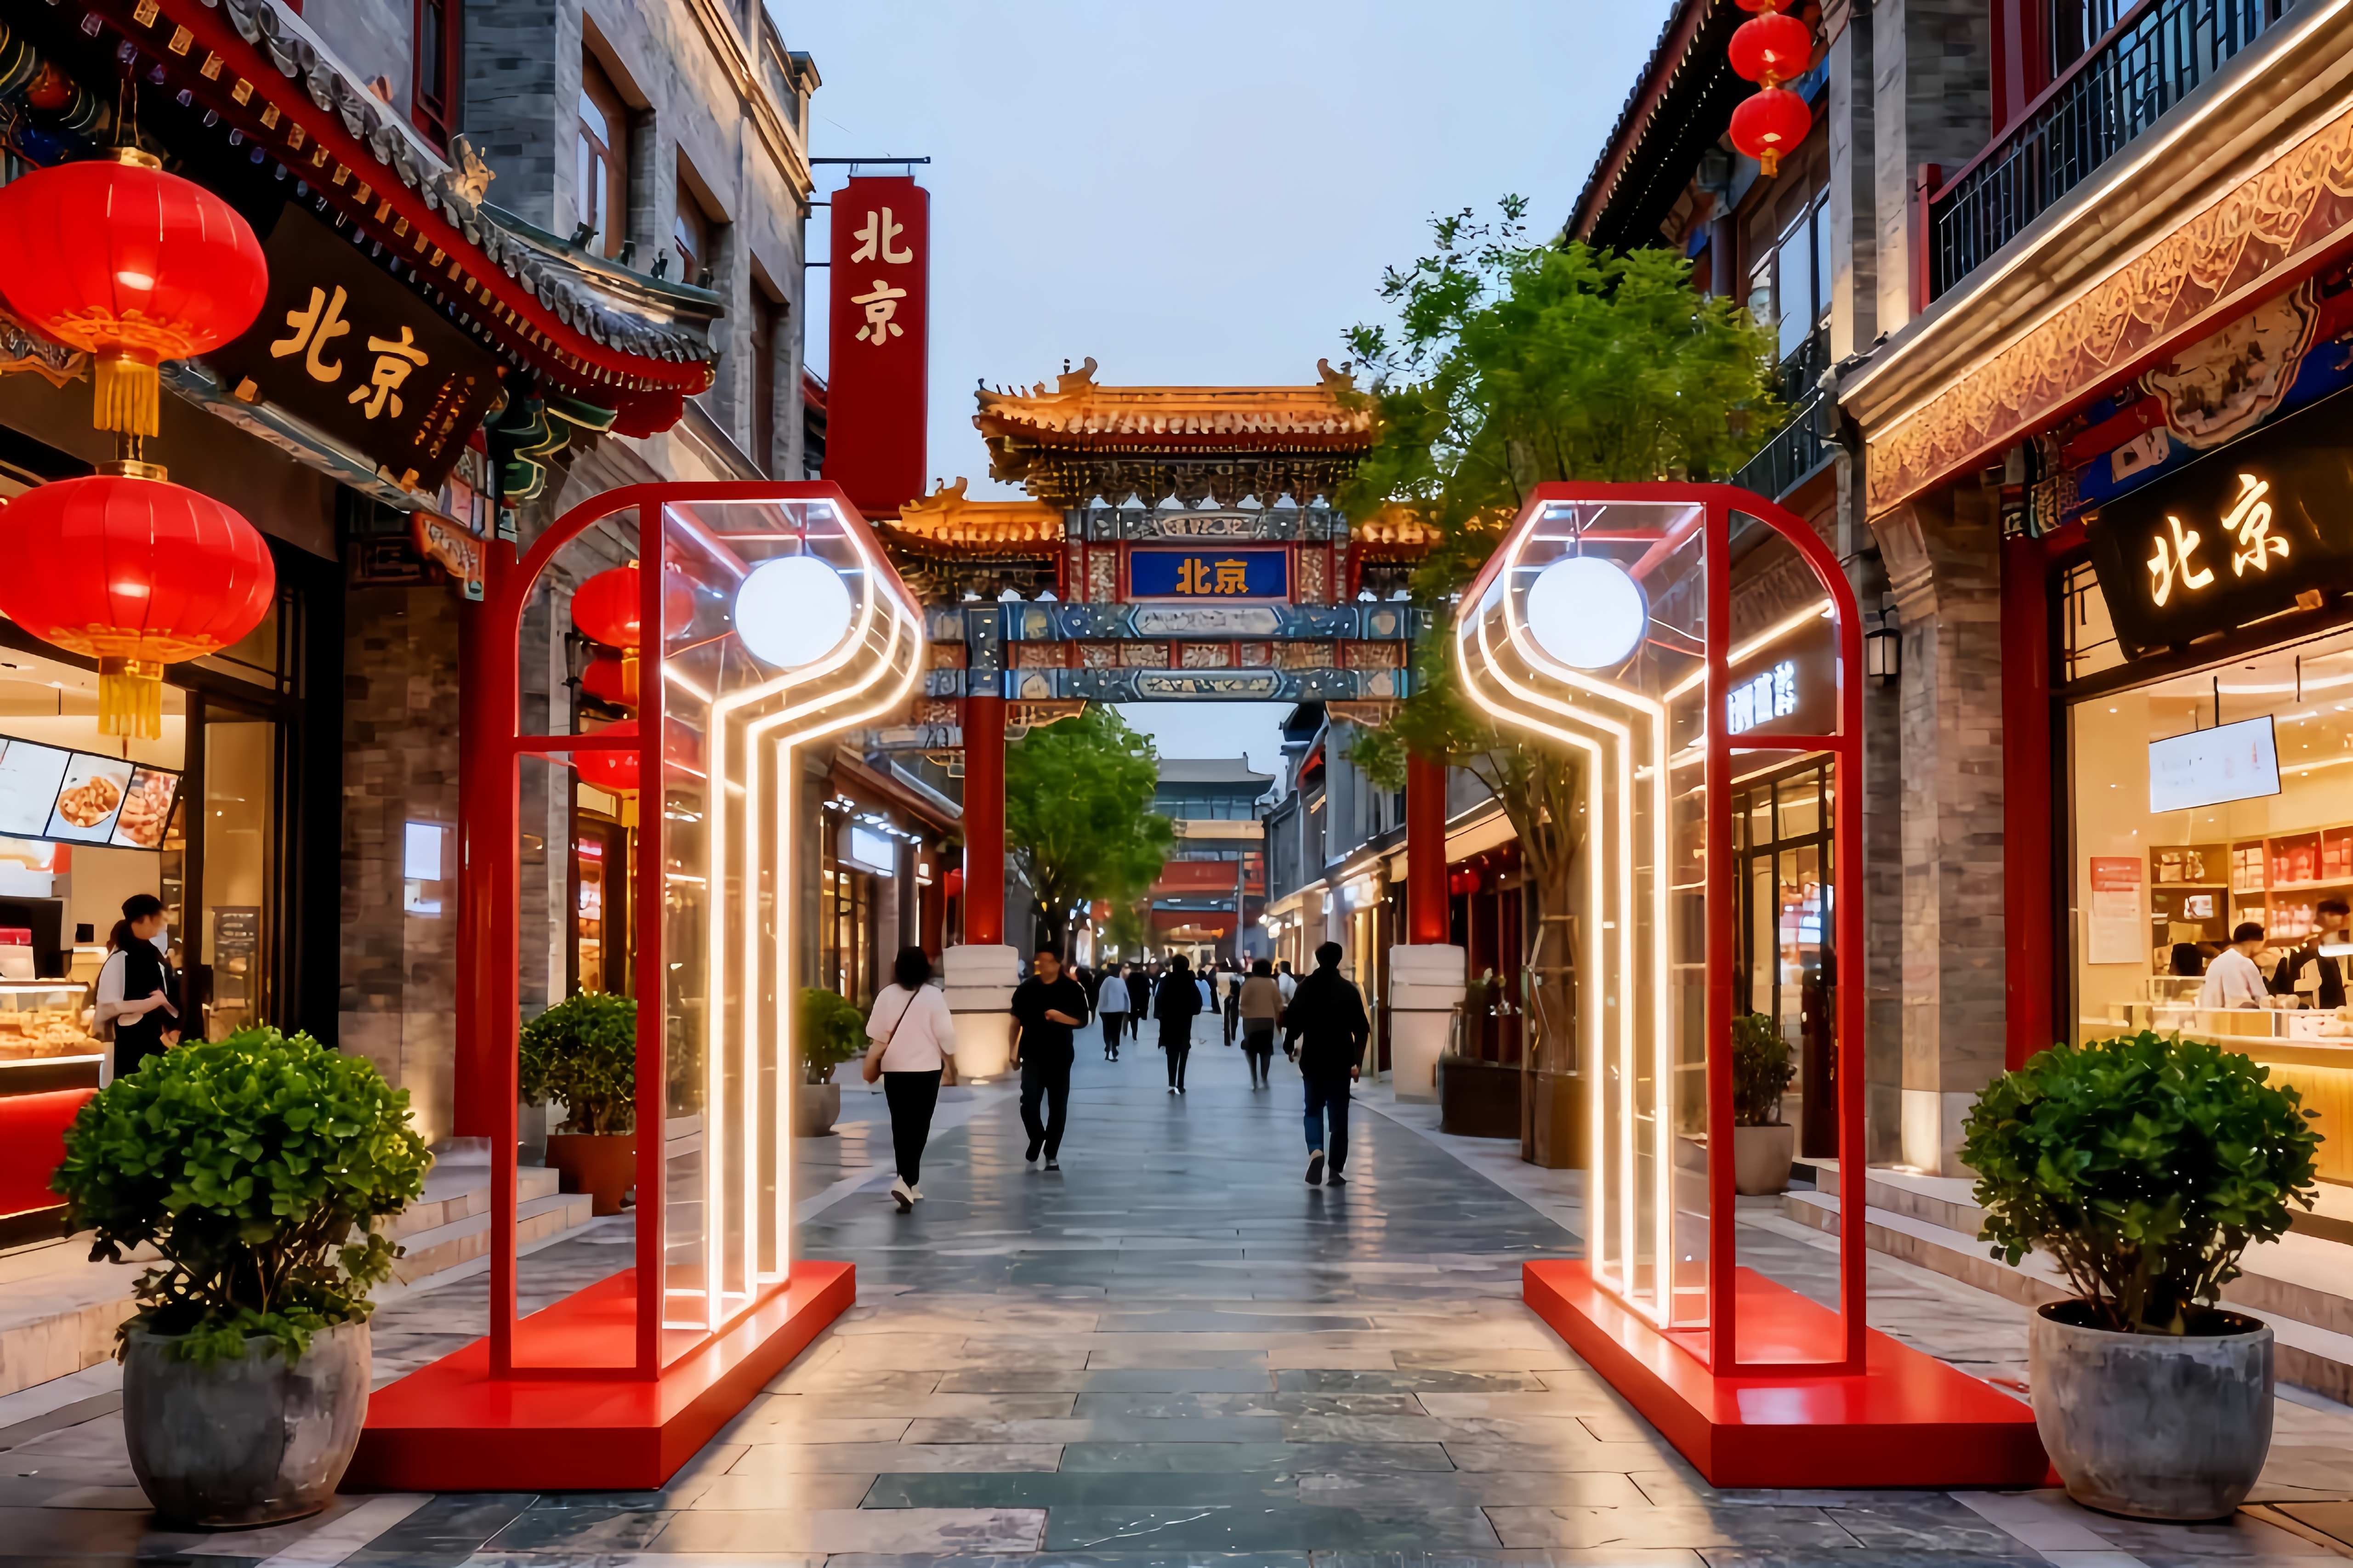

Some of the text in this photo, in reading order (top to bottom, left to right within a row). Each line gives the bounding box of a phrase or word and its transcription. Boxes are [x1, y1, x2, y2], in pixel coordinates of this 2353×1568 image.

[851, 207, 913, 346] 北京
[270, 285, 429, 419] 北京
[1176, 558, 1249, 594] 北京
[2147, 473, 2290, 607] 北京
